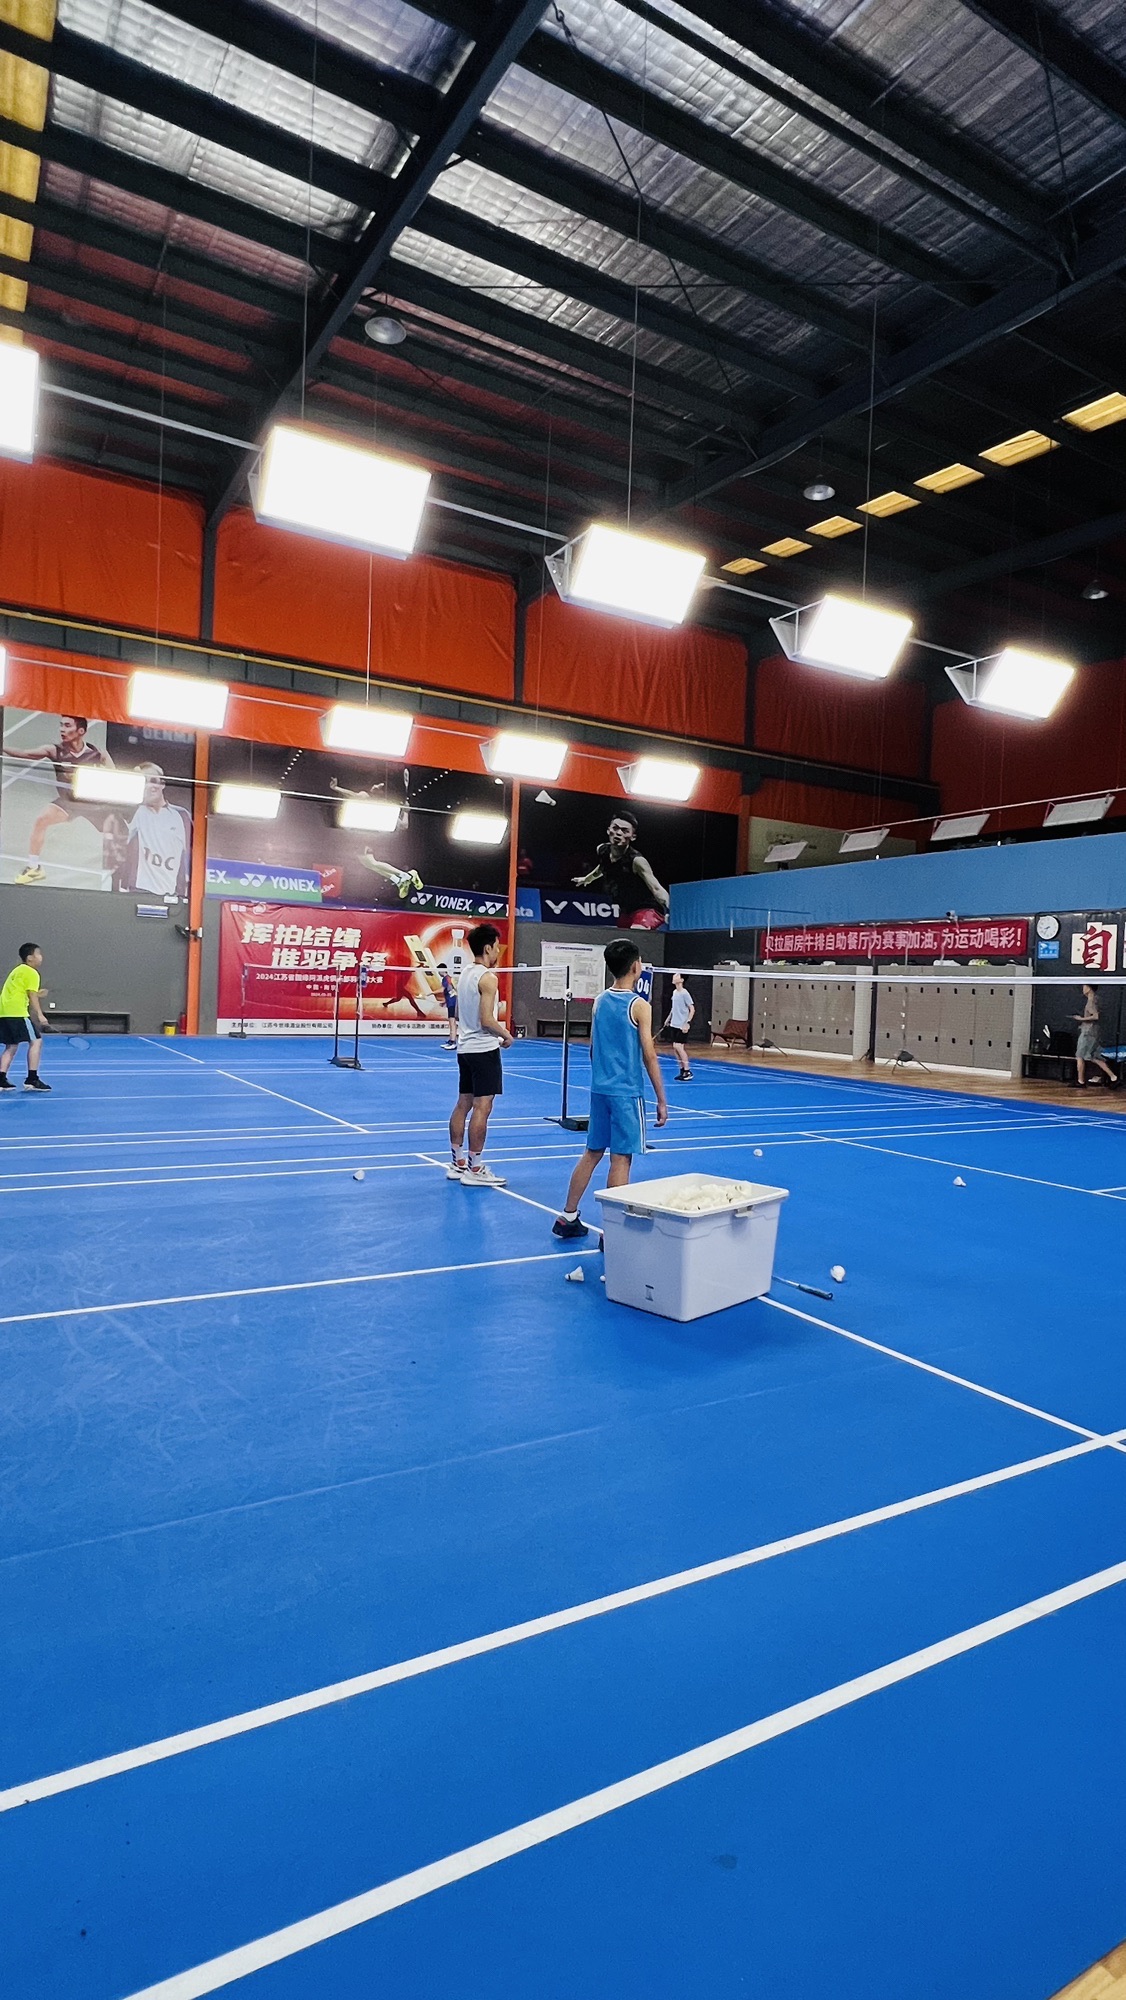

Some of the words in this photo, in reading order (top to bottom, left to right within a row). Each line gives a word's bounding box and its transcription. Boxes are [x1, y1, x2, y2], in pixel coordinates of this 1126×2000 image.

[434, 895, 473, 911] YONEX
[241, 922, 362, 949] 挥拍结缘
[271, 948, 389, 972] 谁羽争锋
[637, 978, 650, 995] 04
